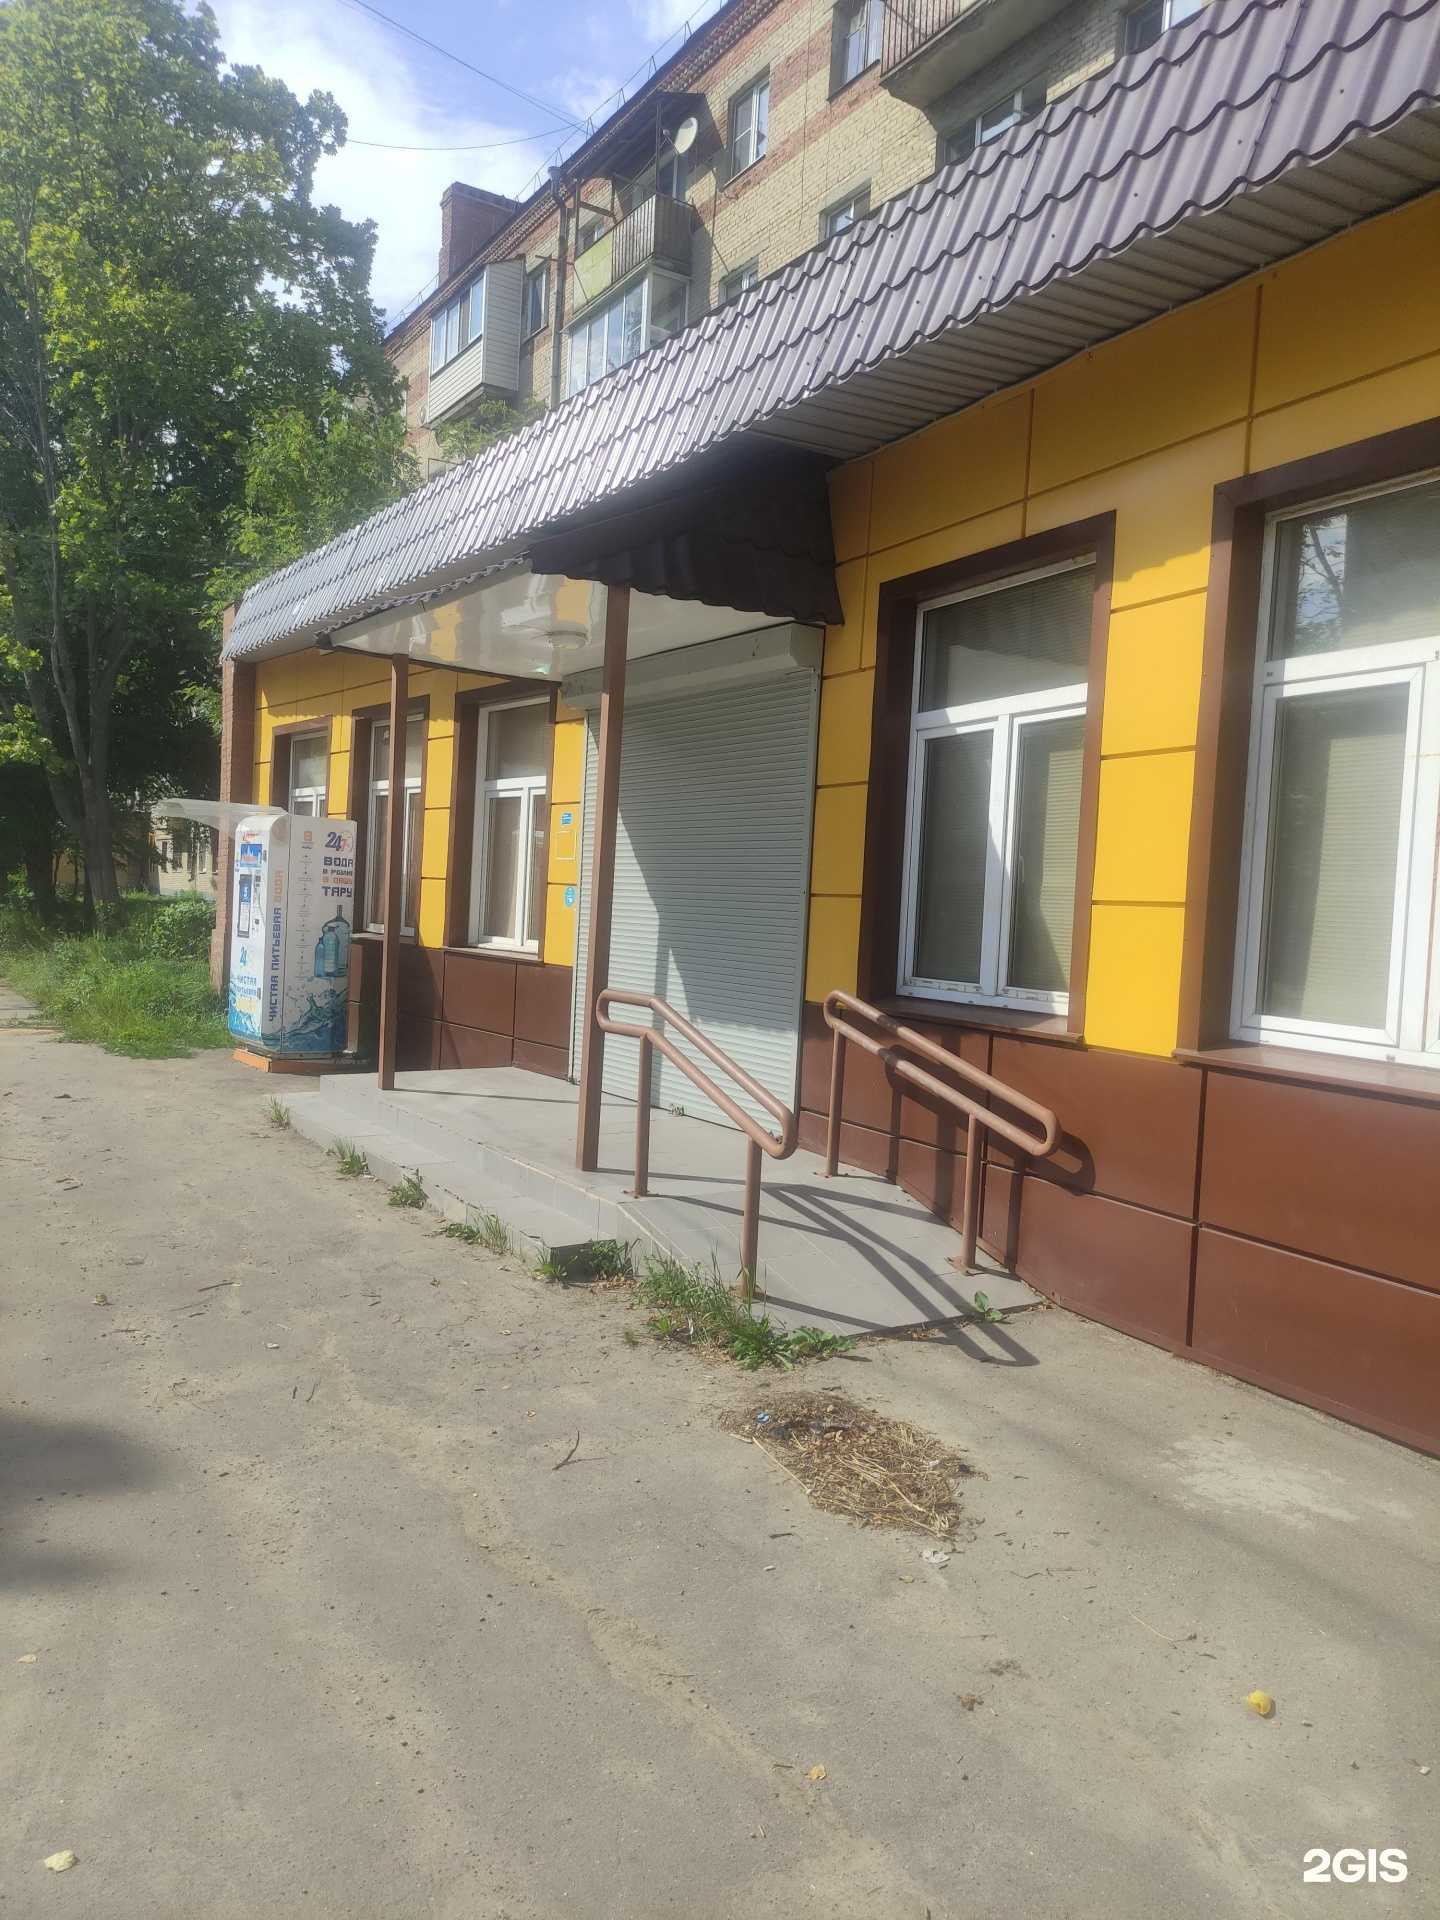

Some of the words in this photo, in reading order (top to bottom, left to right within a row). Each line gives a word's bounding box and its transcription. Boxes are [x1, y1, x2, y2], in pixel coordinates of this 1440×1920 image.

[323, 856, 353, 867] ВОДА
[321, 886, 353, 898] ТАРУ
[271, 907, 282, 971] ПИТЬЕВАЯ
[268, 975, 279, 1022] ЧИСТАЯ
